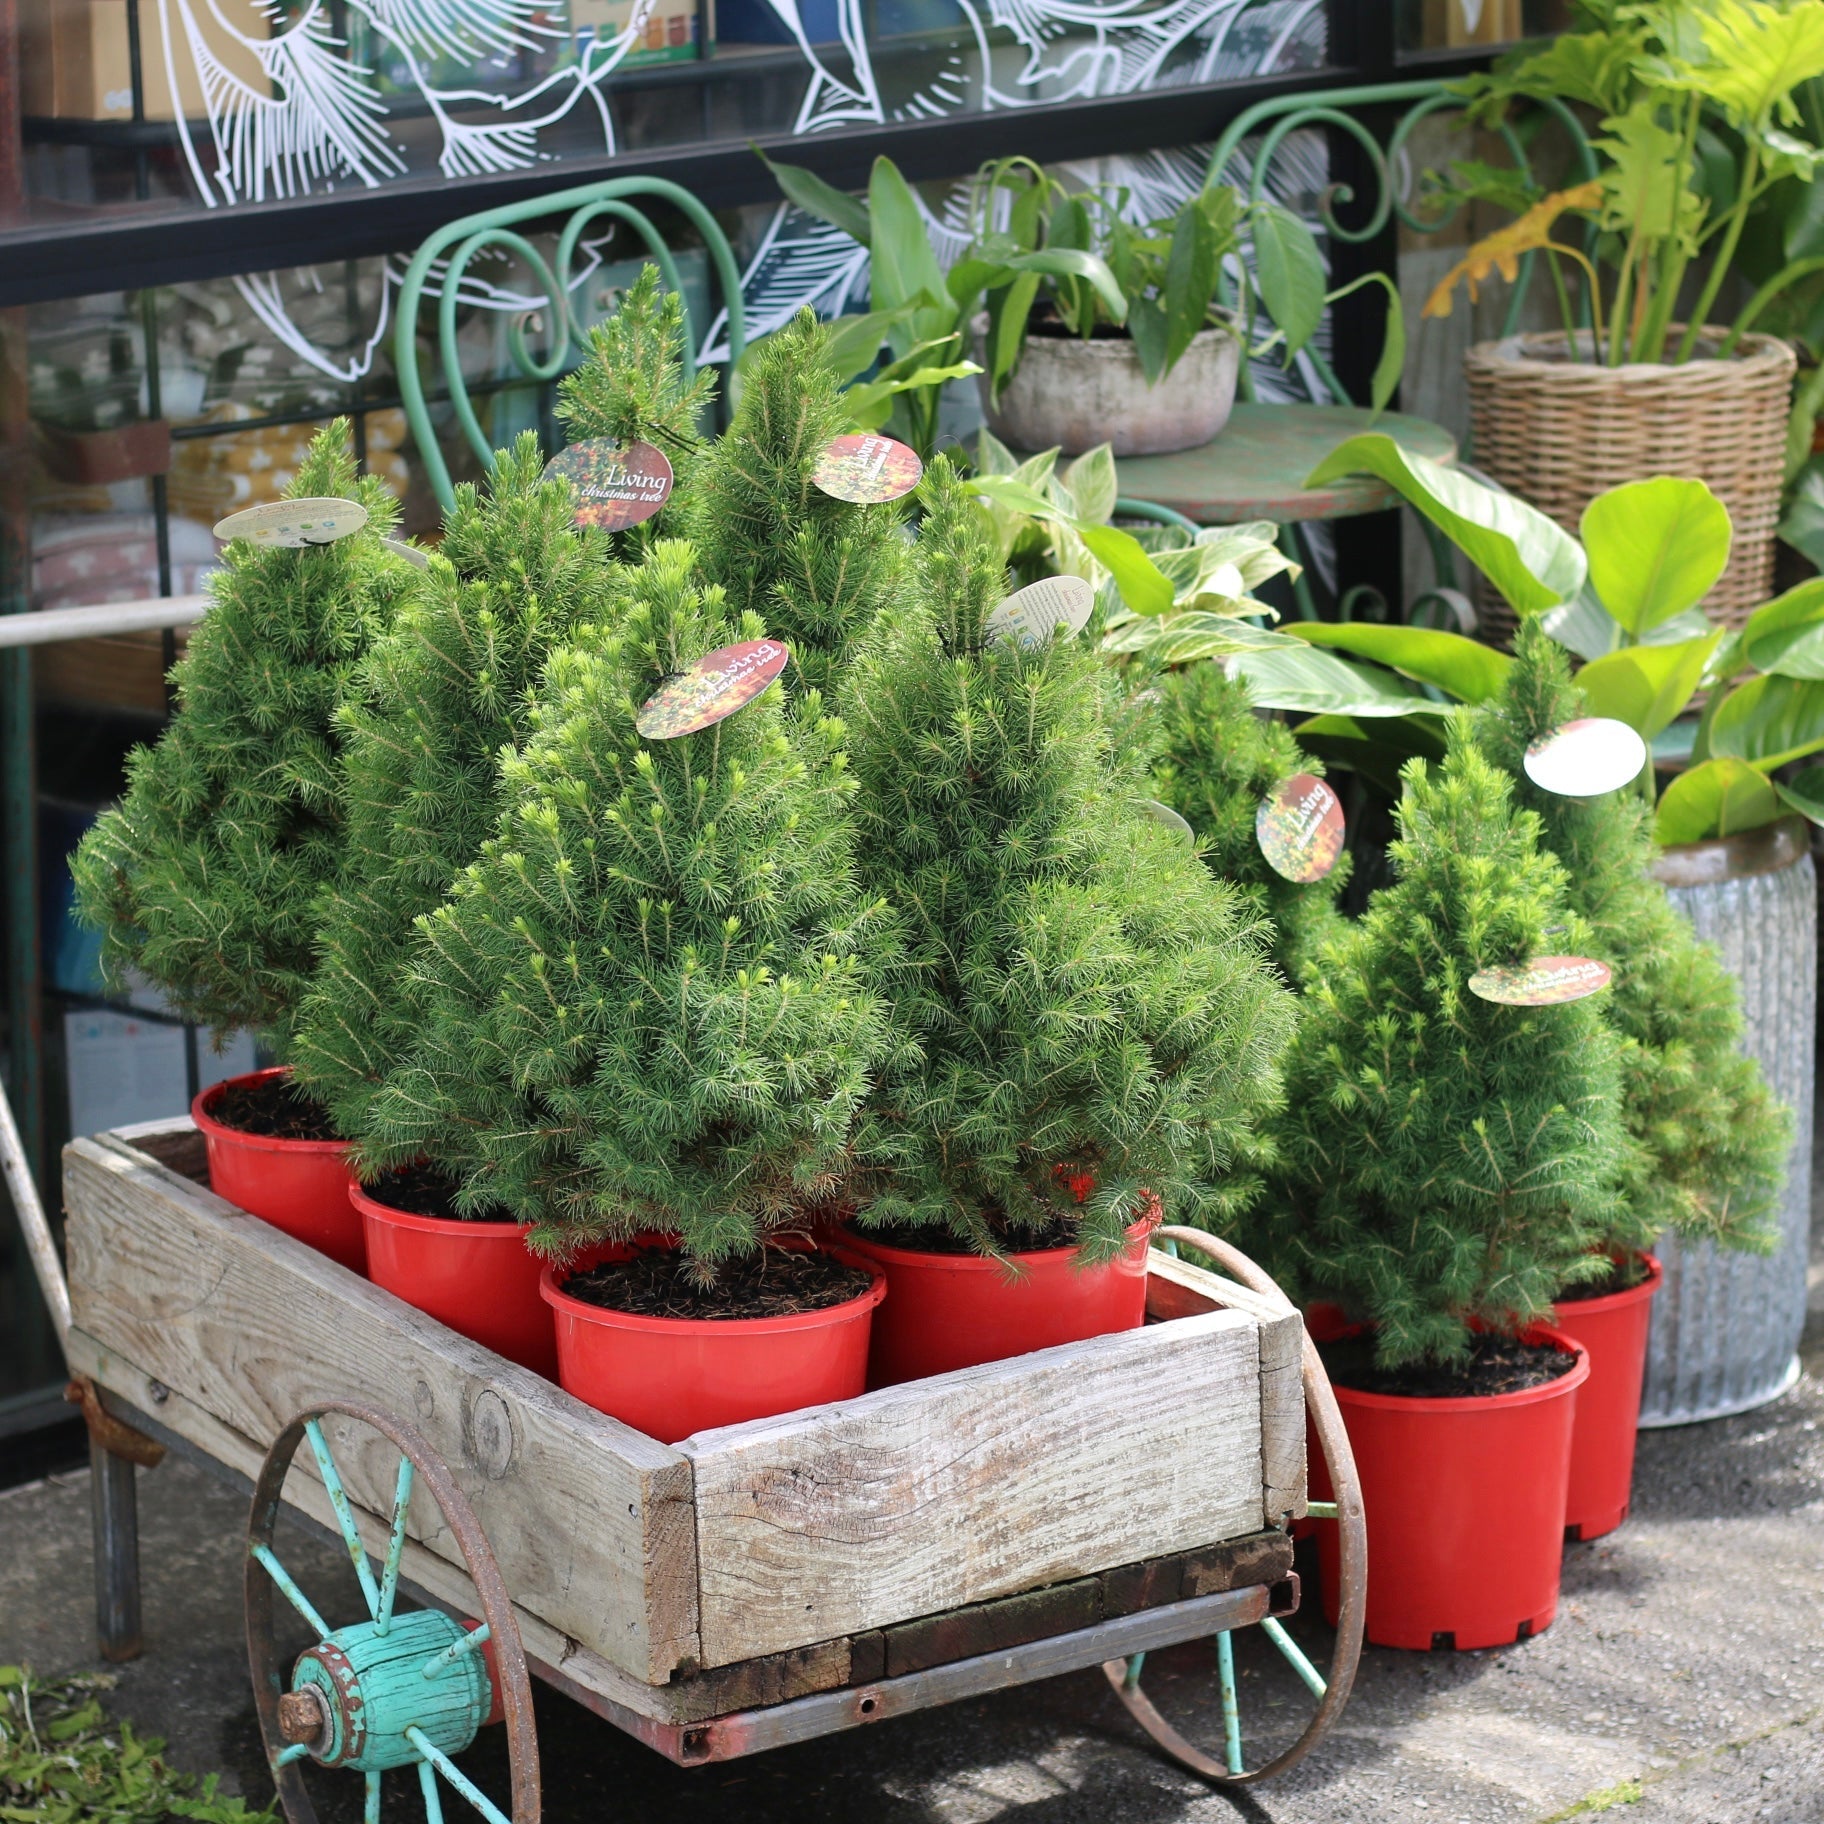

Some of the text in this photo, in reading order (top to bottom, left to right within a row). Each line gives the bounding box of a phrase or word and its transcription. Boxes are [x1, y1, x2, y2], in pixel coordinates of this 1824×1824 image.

[581, 484, 663, 502] christmas tree
[607, 463, 668, 496] Living
[700, 643, 777, 688] Living
[1285, 783, 1331, 829] Living
